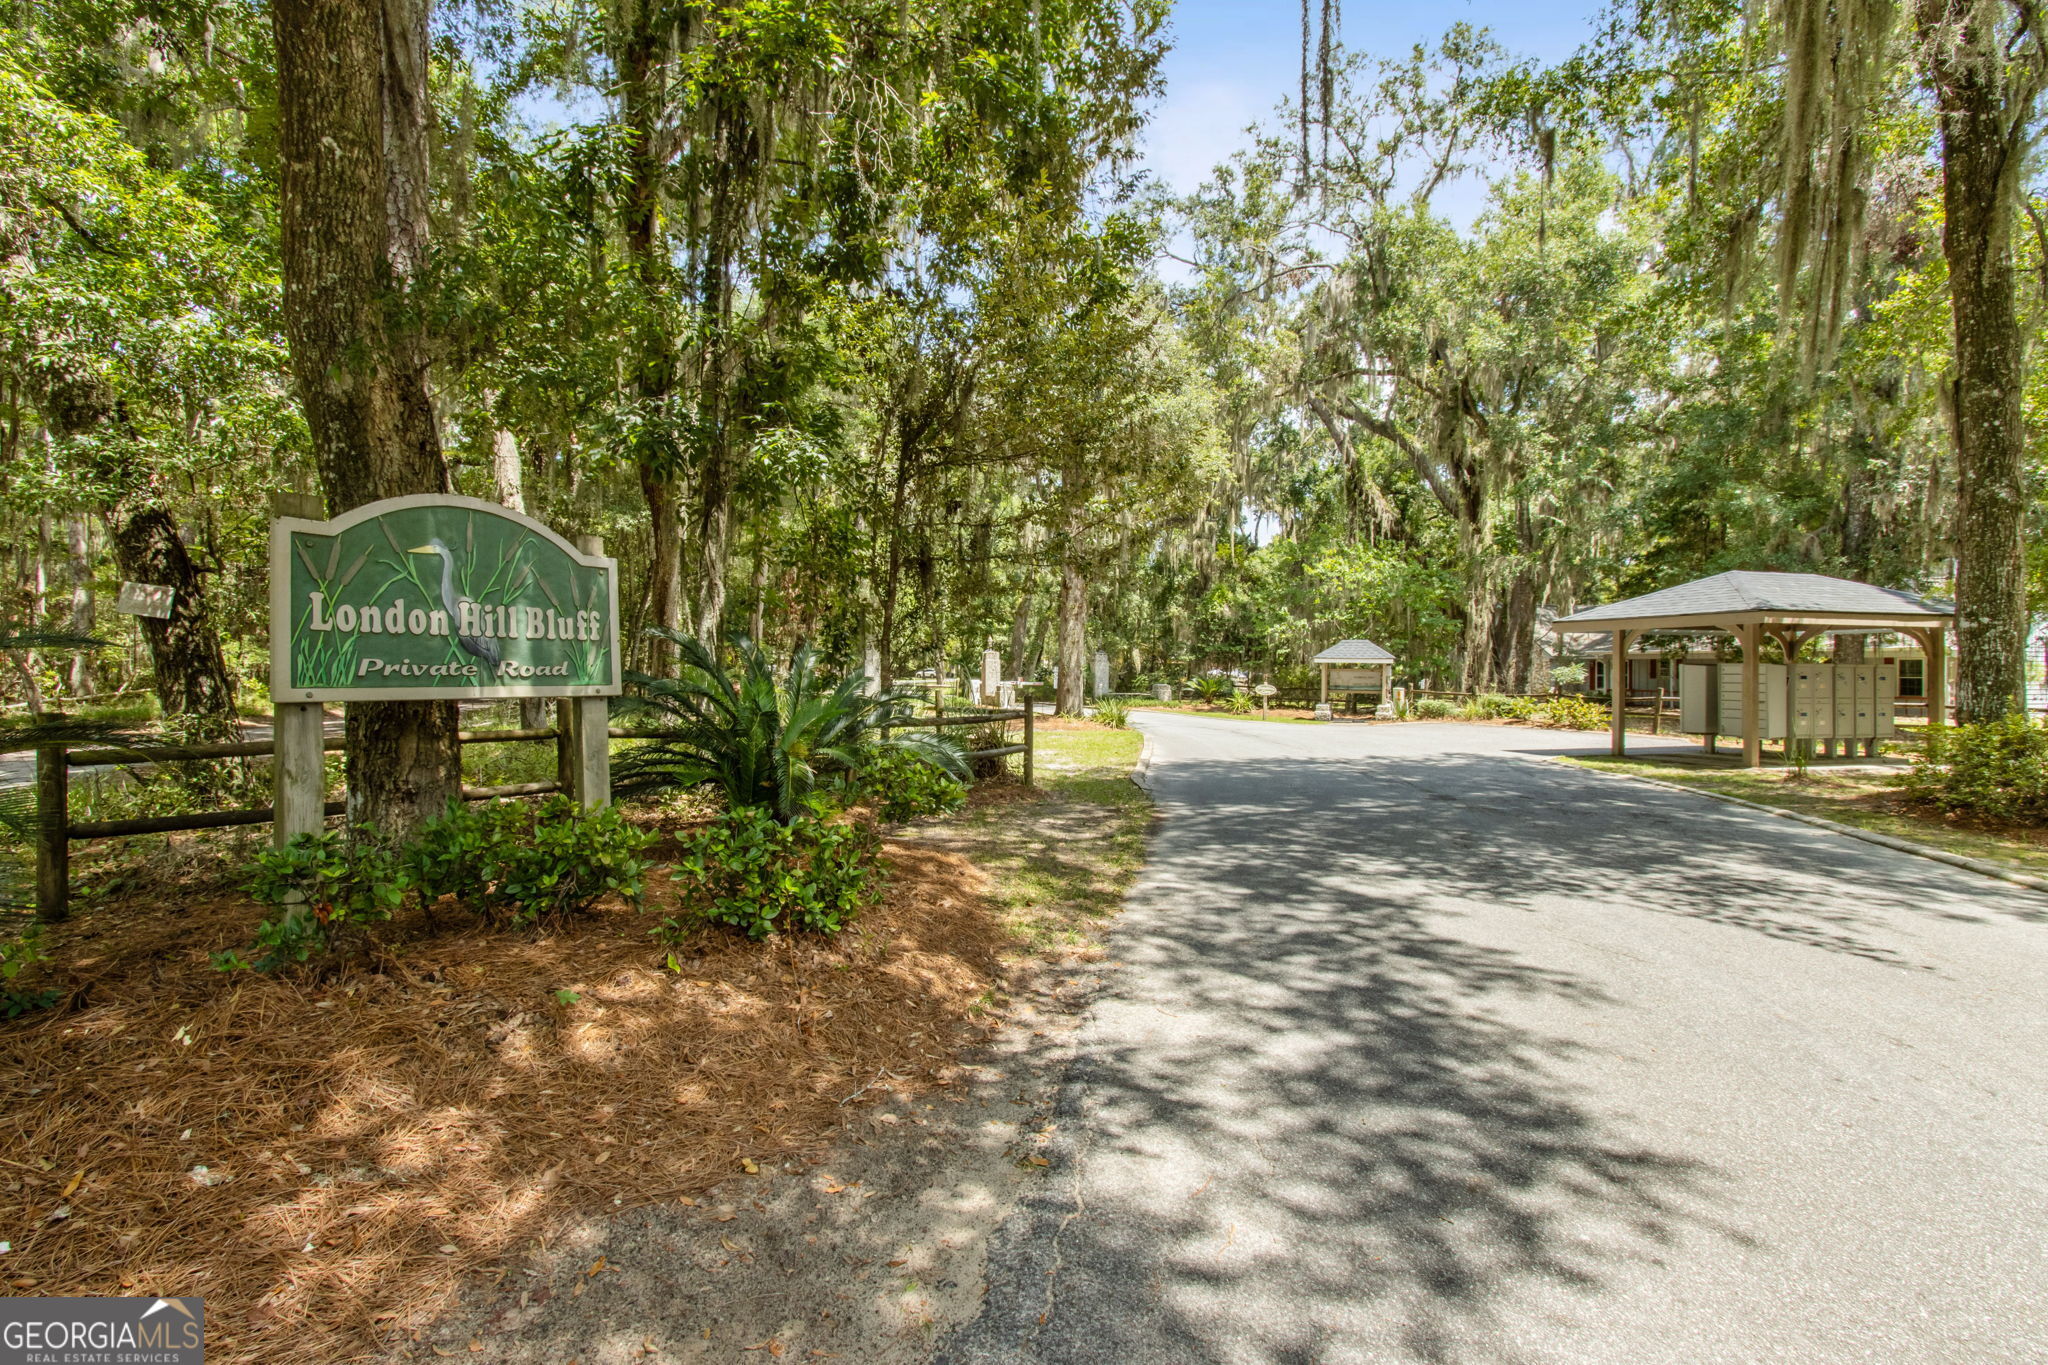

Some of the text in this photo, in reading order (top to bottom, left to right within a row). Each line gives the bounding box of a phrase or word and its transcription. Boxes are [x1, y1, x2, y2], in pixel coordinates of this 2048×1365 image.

[308, 591, 600, 641] London Hill Bluff
[358, 659, 568, 677] Private Road
